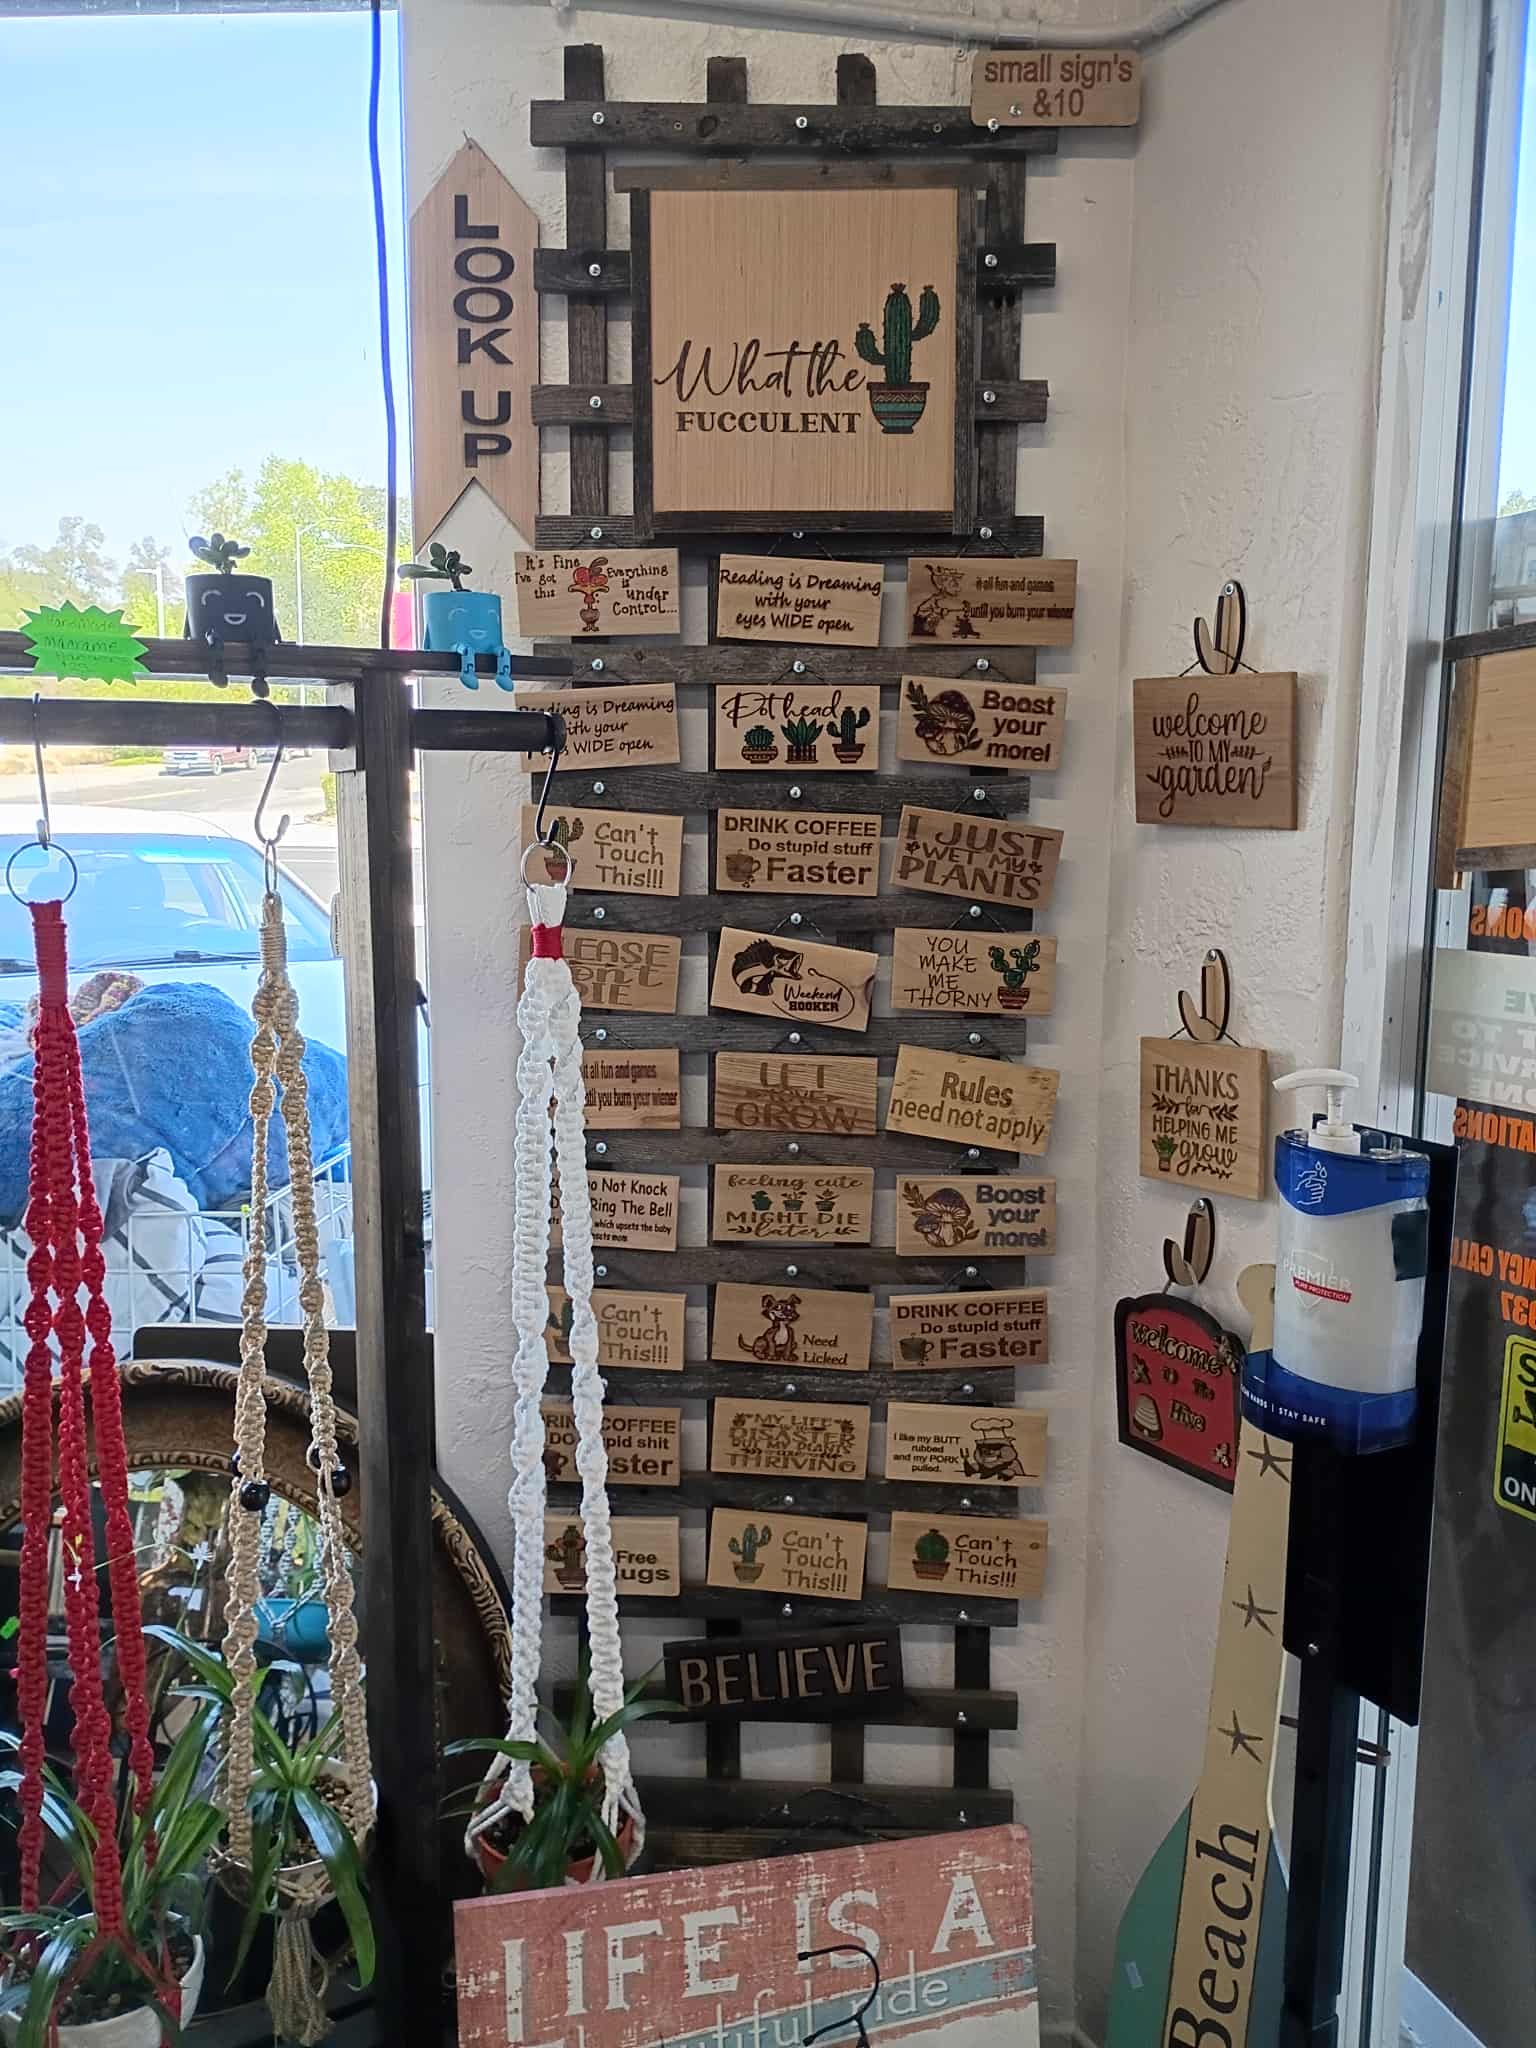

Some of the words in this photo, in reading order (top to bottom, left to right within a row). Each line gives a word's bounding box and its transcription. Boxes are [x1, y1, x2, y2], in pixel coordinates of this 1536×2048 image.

[984, 53, 1051, 83] small
[1060, 53, 1132, 89] sign's
[1033, 88, 1084, 117] &10
[453, 194, 515, 365] LOOK
[654, 339, 796, 402] What
[803, 339, 866, 398] the
[461, 390, 512, 468] UP
[675, 411, 861, 434] FUCCULENT
[526, 555, 544, 570] It's
[553, 555, 580, 569] Fine
[606, 564, 669, 579] Everything
[539, 574, 557, 585] got
[621, 578, 630, 589] is
[719, 569, 784, 590] Reading
[789, 573, 801, 588] is
[806, 574, 881, 597] Dreaming
[534, 587, 555, 599] this
[626, 584, 669, 601] under
[755, 592, 791, 609] with
[794, 598, 831, 612] your
[736, 612, 766, 629] eyes
[770, 614, 814, 629] WIDE
[817, 618, 854, 635] open
[990, 606, 1005, 622] you
[586, 701, 598, 716] is
[603, 698, 674, 714] Dreaming
[982, 689, 1056, 716] Boost
[992, 716, 1047, 737] your
[1152, 692, 1267, 740] welcome
[566, 719, 591, 736] ith
[594, 722, 629, 737] your
[573, 739, 614, 754] WIDE
[619, 739, 654, 755] open
[1187, 739, 1203, 763] TO
[1209, 739, 1231, 763] MY
[1159, 764, 1267, 817] garden
[594, 822, 659, 846] Can't
[724, 815, 789, 835] DRINK
[794, 819, 877, 837] COFFEE
[748, 838, 771, 851] Do
[775, 840, 829, 856] stupid
[833, 842, 873, 856] stuff
[906, 814, 922, 840] I
[935, 821, 1054, 861] JUST
[594, 841, 664, 866] Touch
[923, 842, 982, 866] WET
[988, 853, 1026, 873] MY
[595, 864, 664, 889] This!!!
[766, 857, 872, 885] Faster
[897, 855, 1042, 901] PLANTS
[927, 937, 968, 954] YOU
[919, 956, 977, 973] MAKE
[928, 974, 960, 990] ME
[783, 984, 843, 1002] Weekend
[904, 988, 992, 1008] THORNY
[788, 1001, 840, 1013] HOOKER
[590, 1061, 599, 1080] all
[600, 1060, 614, 1080] fun
[615, 1060, 630, 1079] and
[760, 1062, 833, 1089] LET
[940, 1071, 1014, 1108] Rules
[1152, 1063, 1240, 1101] THANKS
[598, 1091, 612, 1111] you
[613, 1088, 632, 1106] burn
[735, 1102, 857, 1131] GROW
[890, 1097, 945, 1123] need
[947, 1106, 985, 1130] not
[985, 1115, 1045, 1145] apply
[1152, 1115, 1210, 1141] HELPING
[1215, 1124, 1238, 1145] ME
[1177, 1140, 1238, 1177] grow
[602, 1178, 626, 1193] Not
[631, 1179, 668, 1197] Knock
[728, 1174, 807, 1191] feeling
[814, 1175, 863, 1188] cute
[976, 1184, 1047, 1204] Boost
[591, 1198, 617, 1217] Ring
[621, 1199, 646, 1215] The
[649, 1201, 673, 1218] Bell
[726, 1211, 808, 1224] MIGHT
[818, 1212, 860, 1225] DIE
[988, 1208, 1041, 1227] your
[755, 1222, 830, 1239] later
[600, 1303, 663, 1323] Can't
[896, 1303, 959, 1319] DRINK
[964, 1300, 1045, 1316] COFFEE
[600, 1320, 668, 1342] Touch
[920, 1322, 943, 1334] Do
[947, 1320, 999, 1335] stupid
[1003, 1318, 1042, 1331] stuff
[803, 1334, 839, 1348] Need
[940, 1336, 1042, 1360] Faster
[602, 1342, 669, 1364] This!!!
[803, 1352, 848, 1366] Licked
[601, 1416, 676, 1434] COFFEE
[1168, 1400, 1207, 1433] Hive
[1278, 1407, 1299, 1420] STAY
[1302, 1413, 1327, 1426] SAFE
[637, 1436, 669, 1450] shit
[933, 1434, 961, 1445] BUTT
[725, 1452, 856, 1473] THRIVING
[929, 1454, 960, 1464] PORK
[782, 1530, 844, 1553] Can't
[955, 1533, 1012, 1552] Can't
[616, 1550, 658, 1564] Free
[781, 1547, 848, 1570] Touch
[954, 1548, 1017, 1569] Touch
[615, 1565, 671, 1585] ugs
[781, 1569, 848, 1593] This!!!
[955, 1567, 1017, 1588] This!!!
[680, 1641, 889, 1707] BELIEVE
[793, 1888, 881, 1975] IS
[930, 1874, 995, 1953] A
